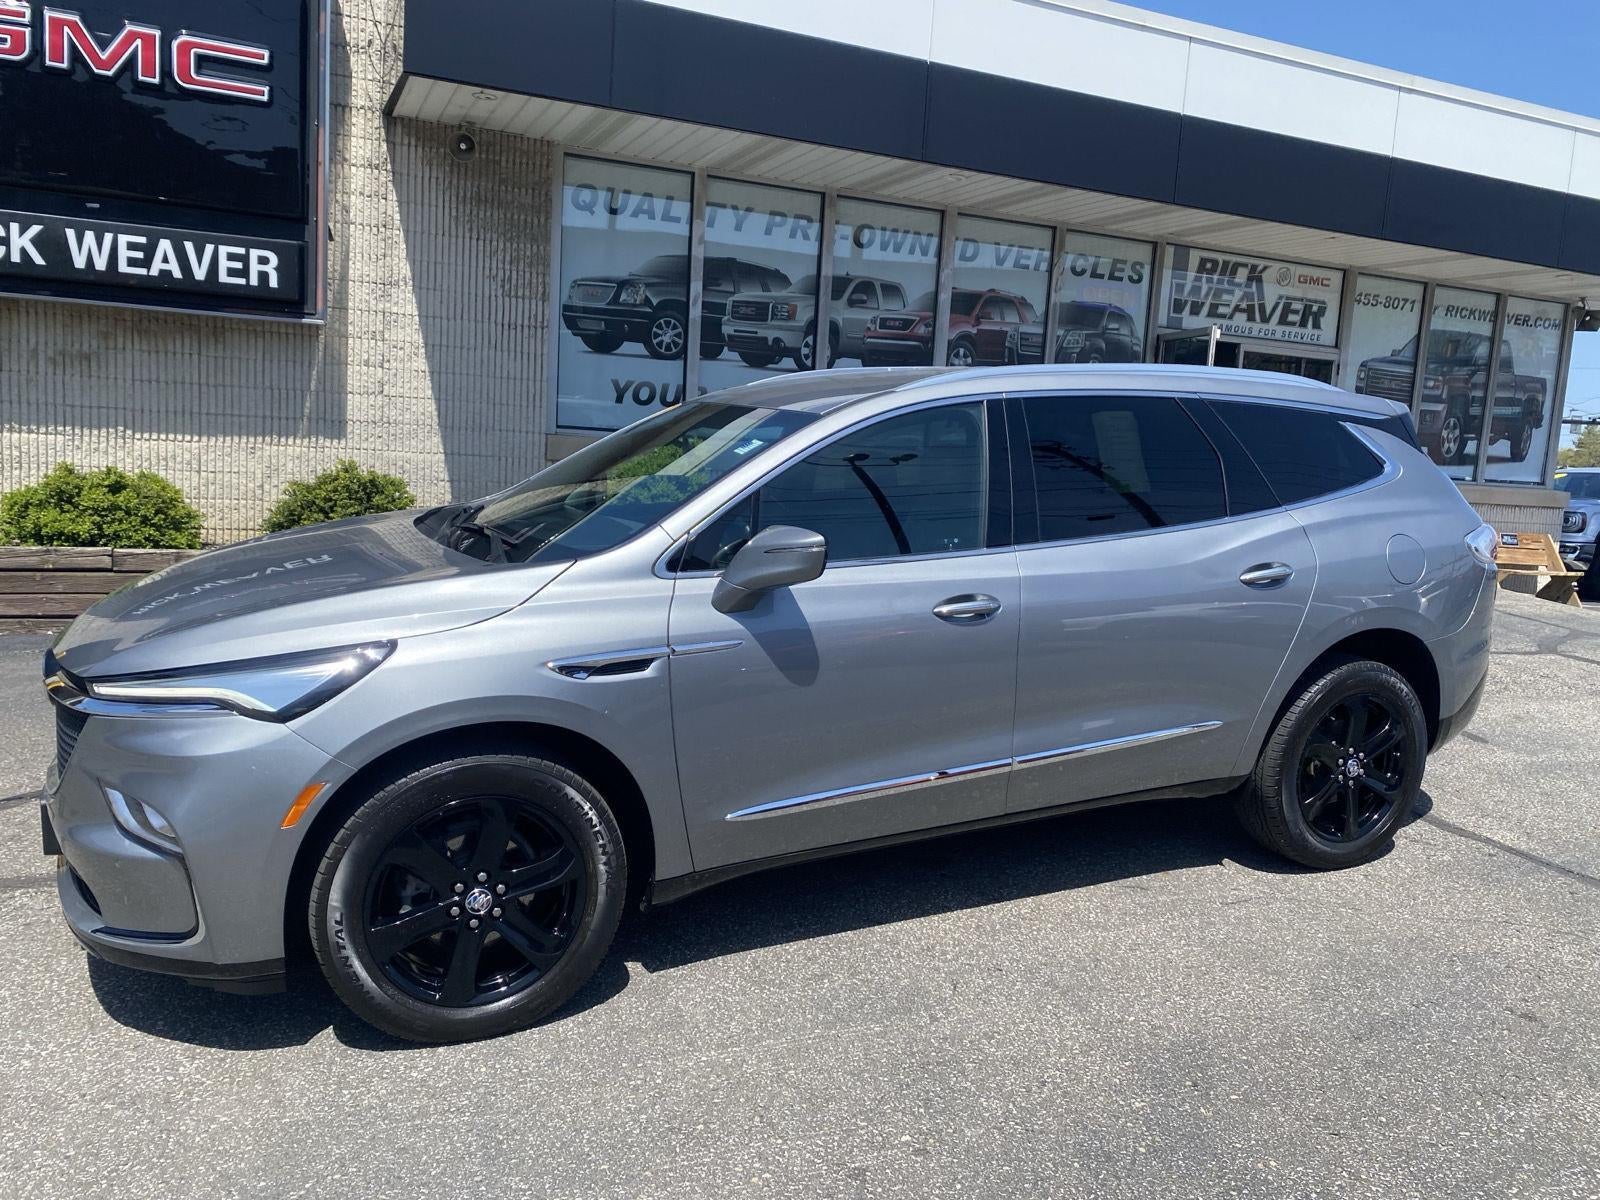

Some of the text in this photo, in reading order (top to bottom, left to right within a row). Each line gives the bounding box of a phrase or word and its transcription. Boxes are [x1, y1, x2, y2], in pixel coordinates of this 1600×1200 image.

[0, 2, 270, 102] MC
[570, 183, 754, 233] QUALTY
[764, 209, 981, 263] PR-OWND
[64, 227, 278, 288] WEAVER
[1193, 255, 1273, 291] RICK
[1297, 273, 1331, 288] GMC
[1172, 279, 1328, 330] WEAVER
[1355, 292, 1416, 313] 455-8071
[1445, 304, 1561, 331] RICKWEVER.COM
[1213, 323, 1322, 342] AMOUS FOR SERVICE
